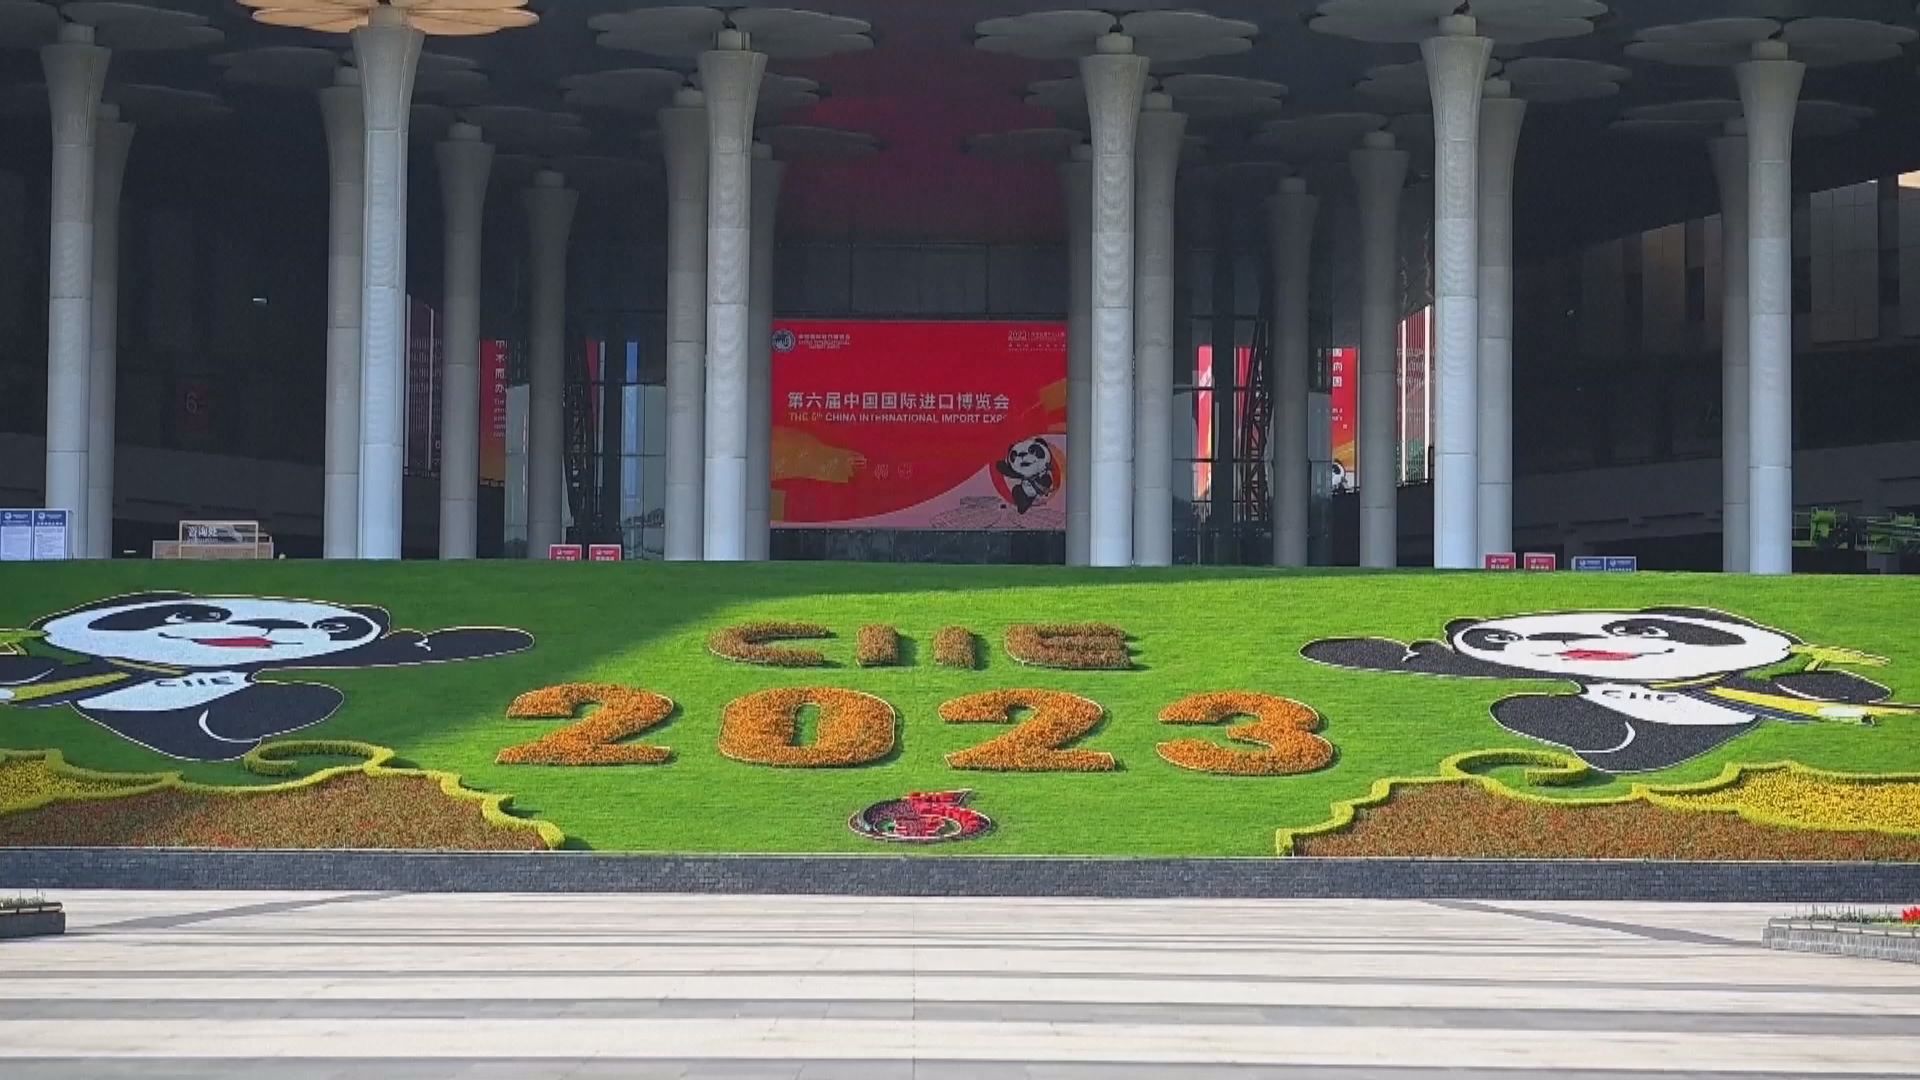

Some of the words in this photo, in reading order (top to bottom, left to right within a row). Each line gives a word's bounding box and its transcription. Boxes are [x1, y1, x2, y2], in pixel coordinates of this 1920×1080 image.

[788, 391, 1010, 410] 第六届中国国际进口博览会
[825, 412, 857, 422] CHINA
[859, 413, 939, 423] INTERNATIONAL
[941, 413, 981, 423] IMPORT
[709, 621, 1133, 671] CIIE
[495, 683, 1336, 777] 2023
